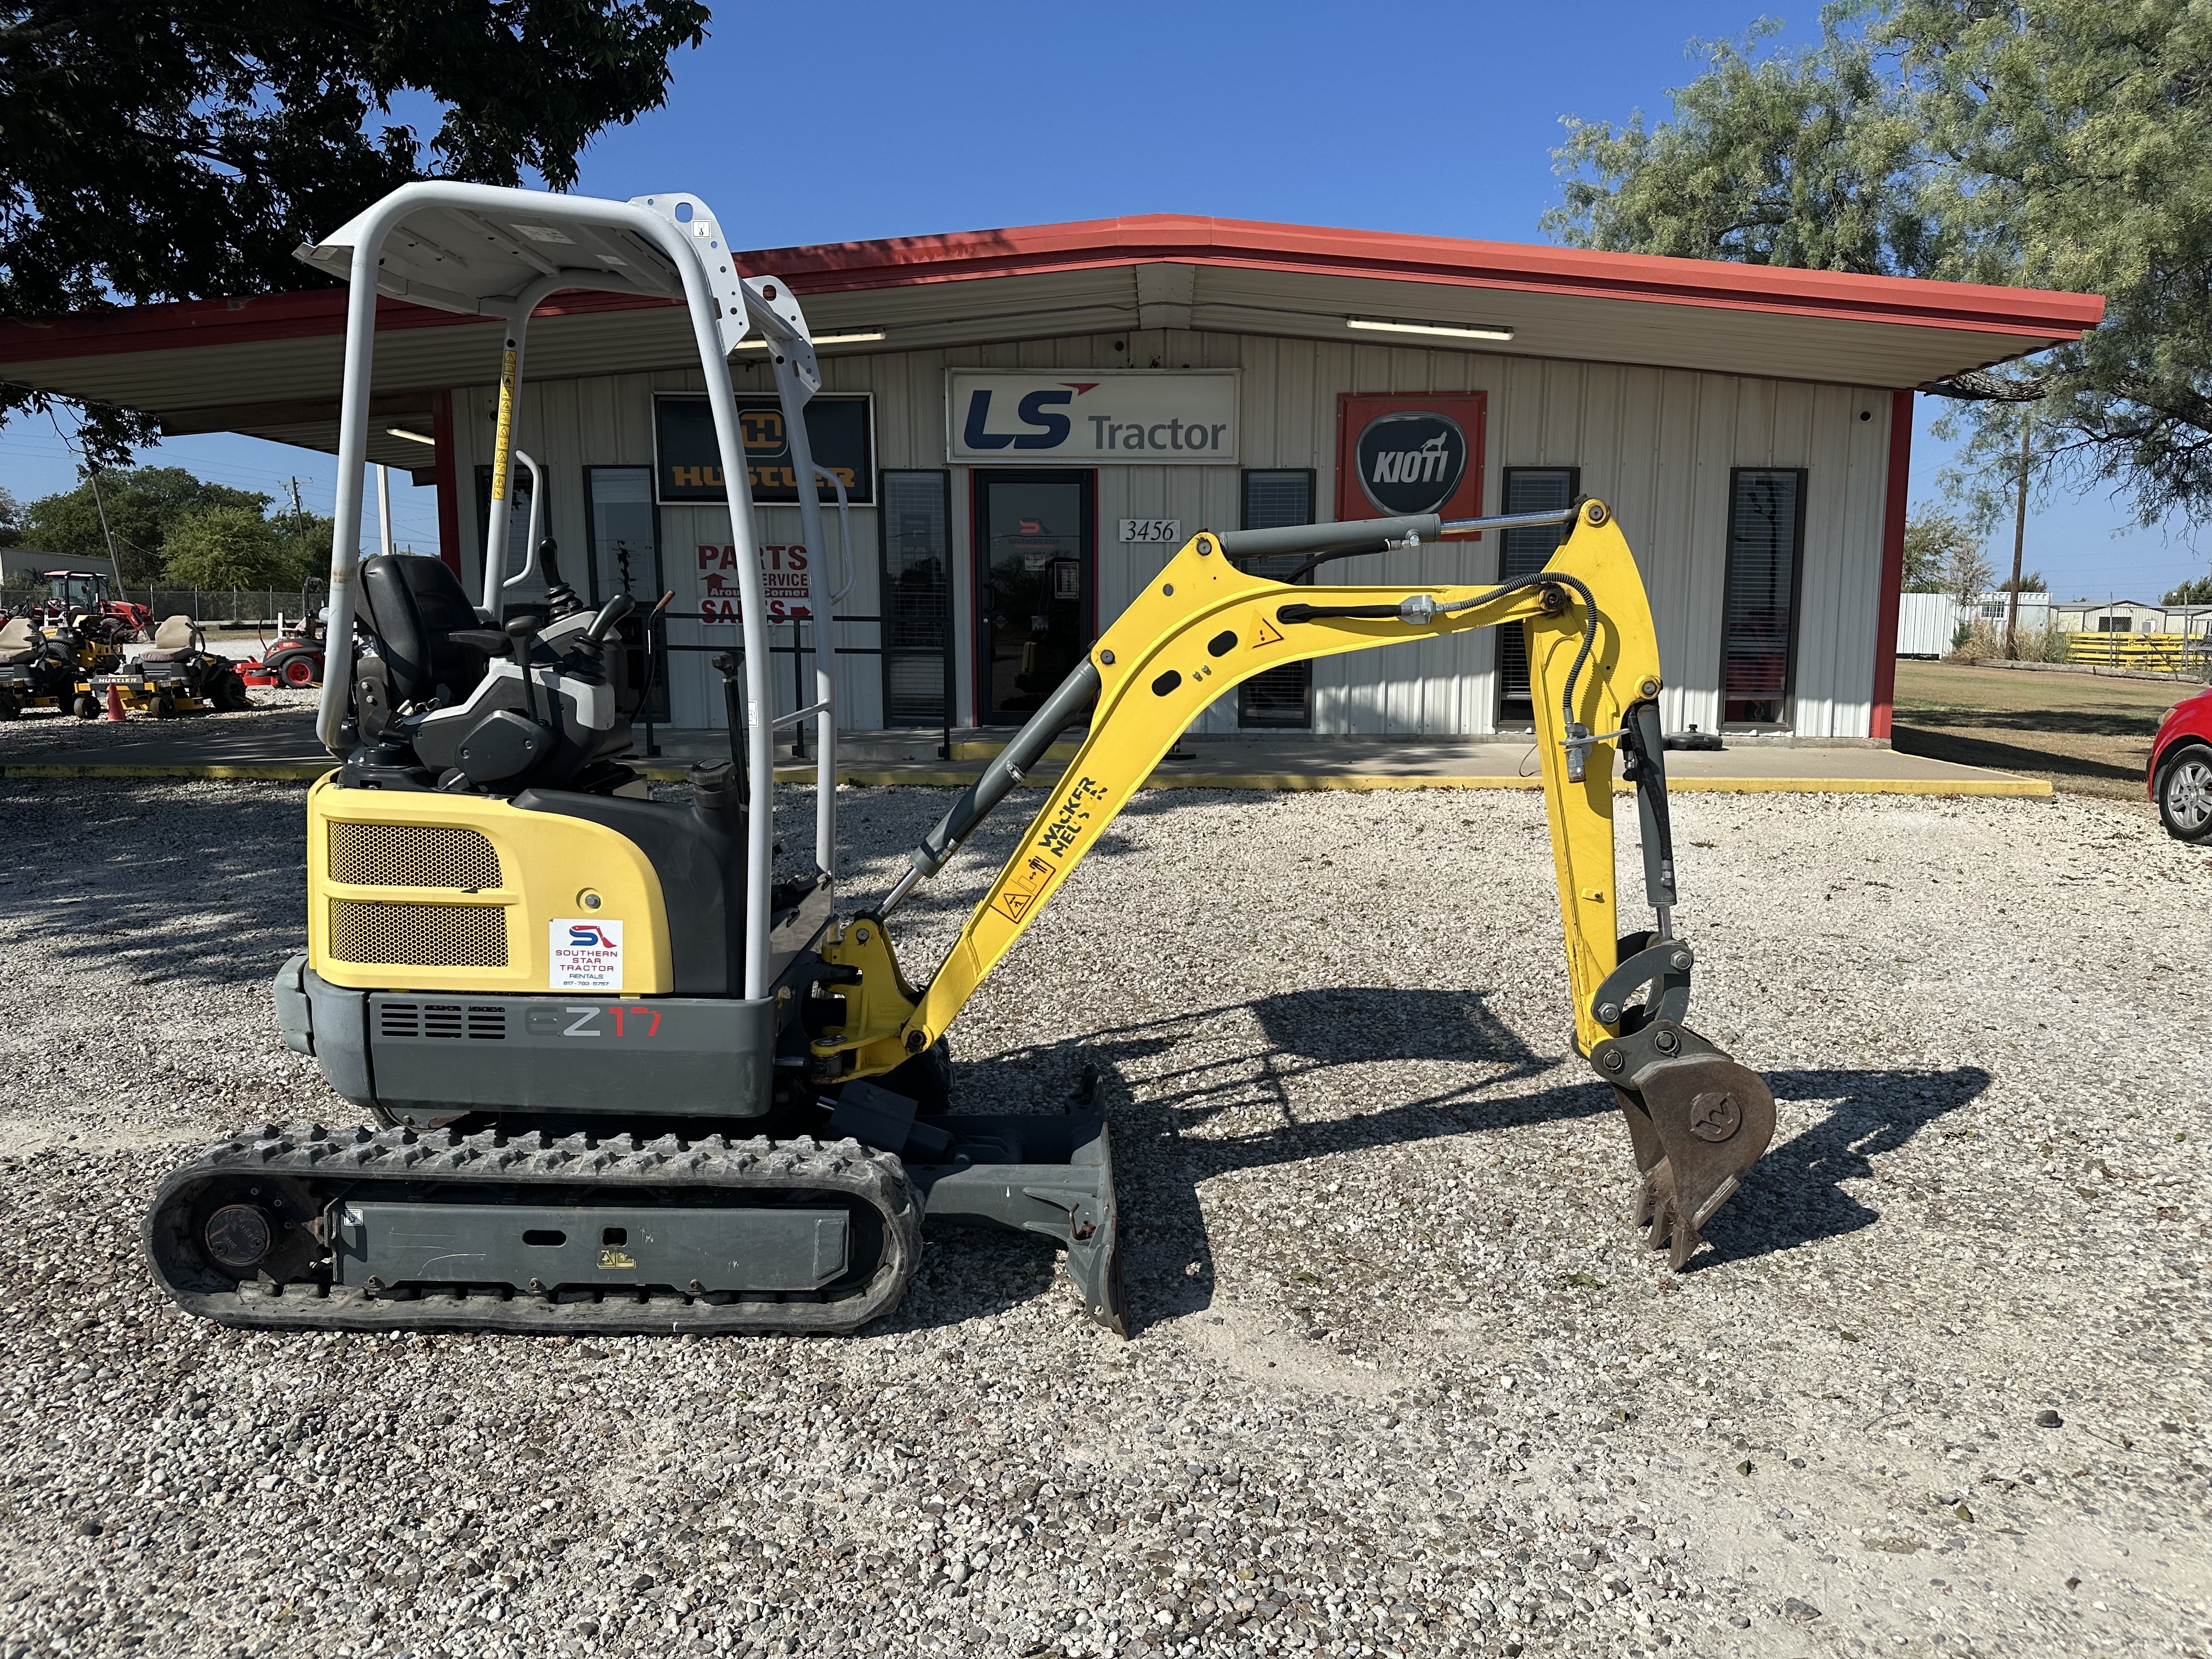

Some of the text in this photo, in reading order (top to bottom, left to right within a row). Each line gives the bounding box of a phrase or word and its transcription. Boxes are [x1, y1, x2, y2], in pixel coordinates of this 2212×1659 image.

[963, 390, 1226, 450] LS Tractor
[1373, 450, 1449, 483] KIOTI
[1126, 520, 1175, 542] 3456
[698, 545, 808, 571] PATS
[761, 573, 808, 586] ERVICE
[764, 588, 806, 597] Corner
[701, 600, 785, 624] SAS
[1037, 776, 1097, 848] WACKER
